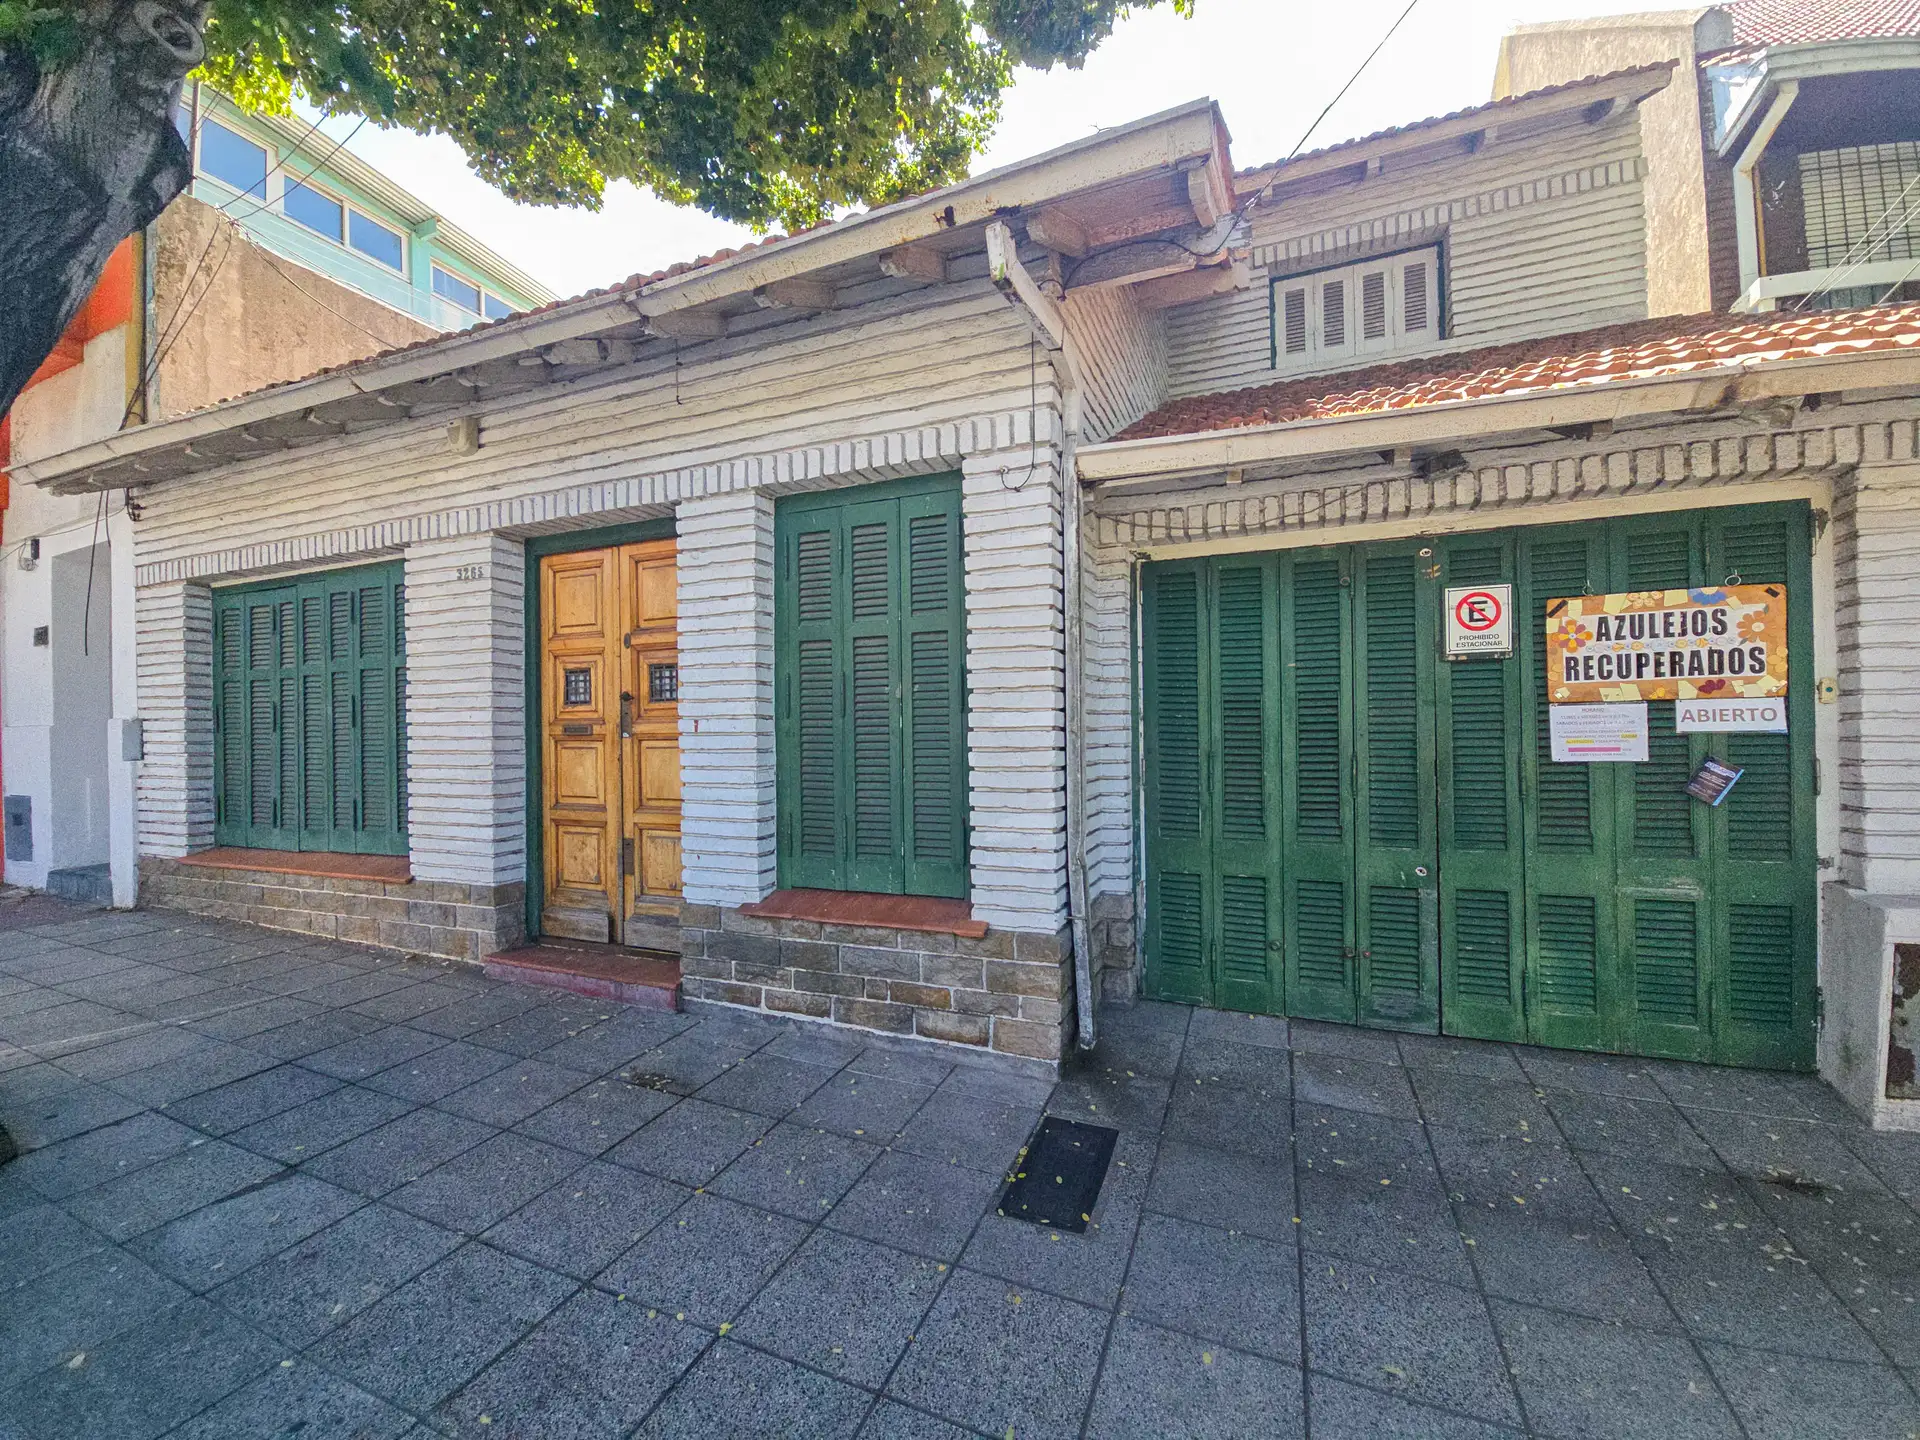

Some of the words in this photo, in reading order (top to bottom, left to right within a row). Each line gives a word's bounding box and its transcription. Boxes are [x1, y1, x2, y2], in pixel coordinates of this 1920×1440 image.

[1468, 600, 1489, 622] E
[1596, 608, 1728, 642] AZULEJOS
[1456, 640, 1503, 648] ESTACIONAR
[1459, 633, 1500, 641] PROHIBIDO
[1565, 646, 1766, 682] RECUPERADOS
[1681, 707, 1778, 723] ABIERTO
